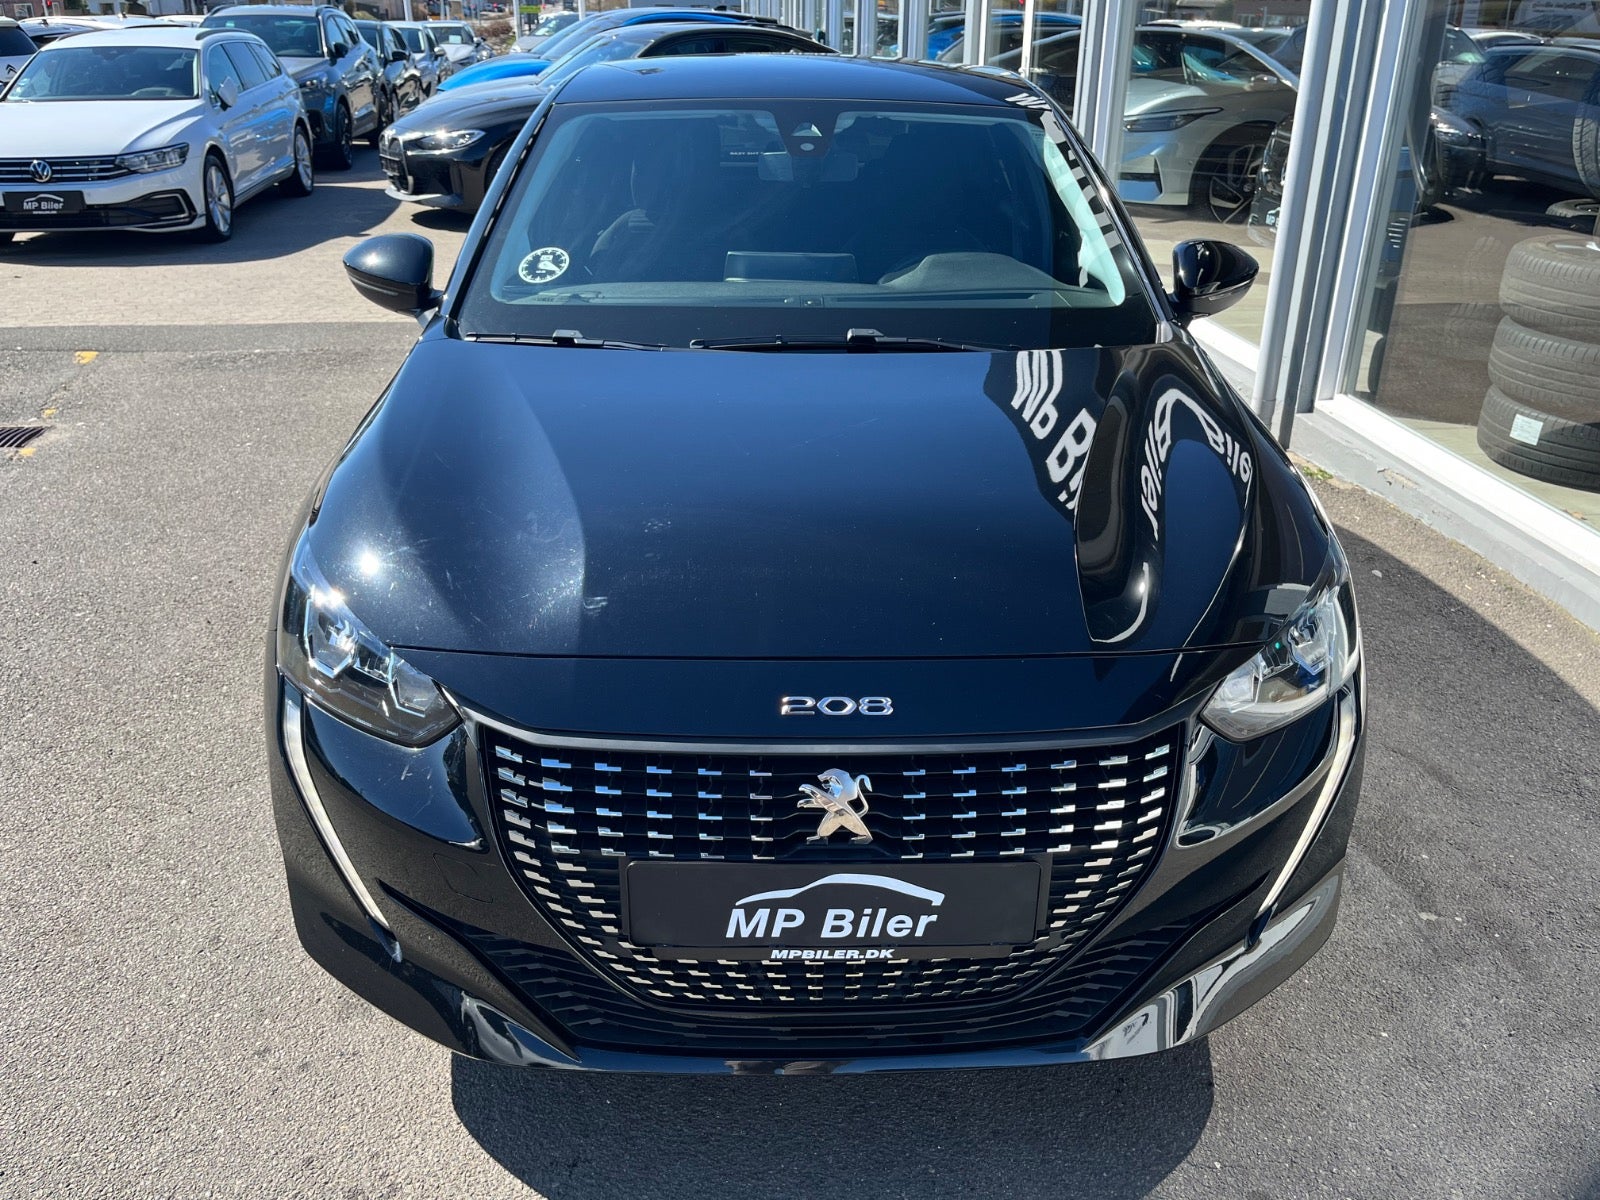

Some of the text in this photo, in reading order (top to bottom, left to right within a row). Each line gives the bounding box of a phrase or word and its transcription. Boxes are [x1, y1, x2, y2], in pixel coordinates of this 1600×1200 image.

[23, 201, 64, 210] MP Biler
[781, 696, 894, 716] 208
[725, 907, 938, 939] MP Biler
[770, 948, 896, 960] MPBILER.DK
